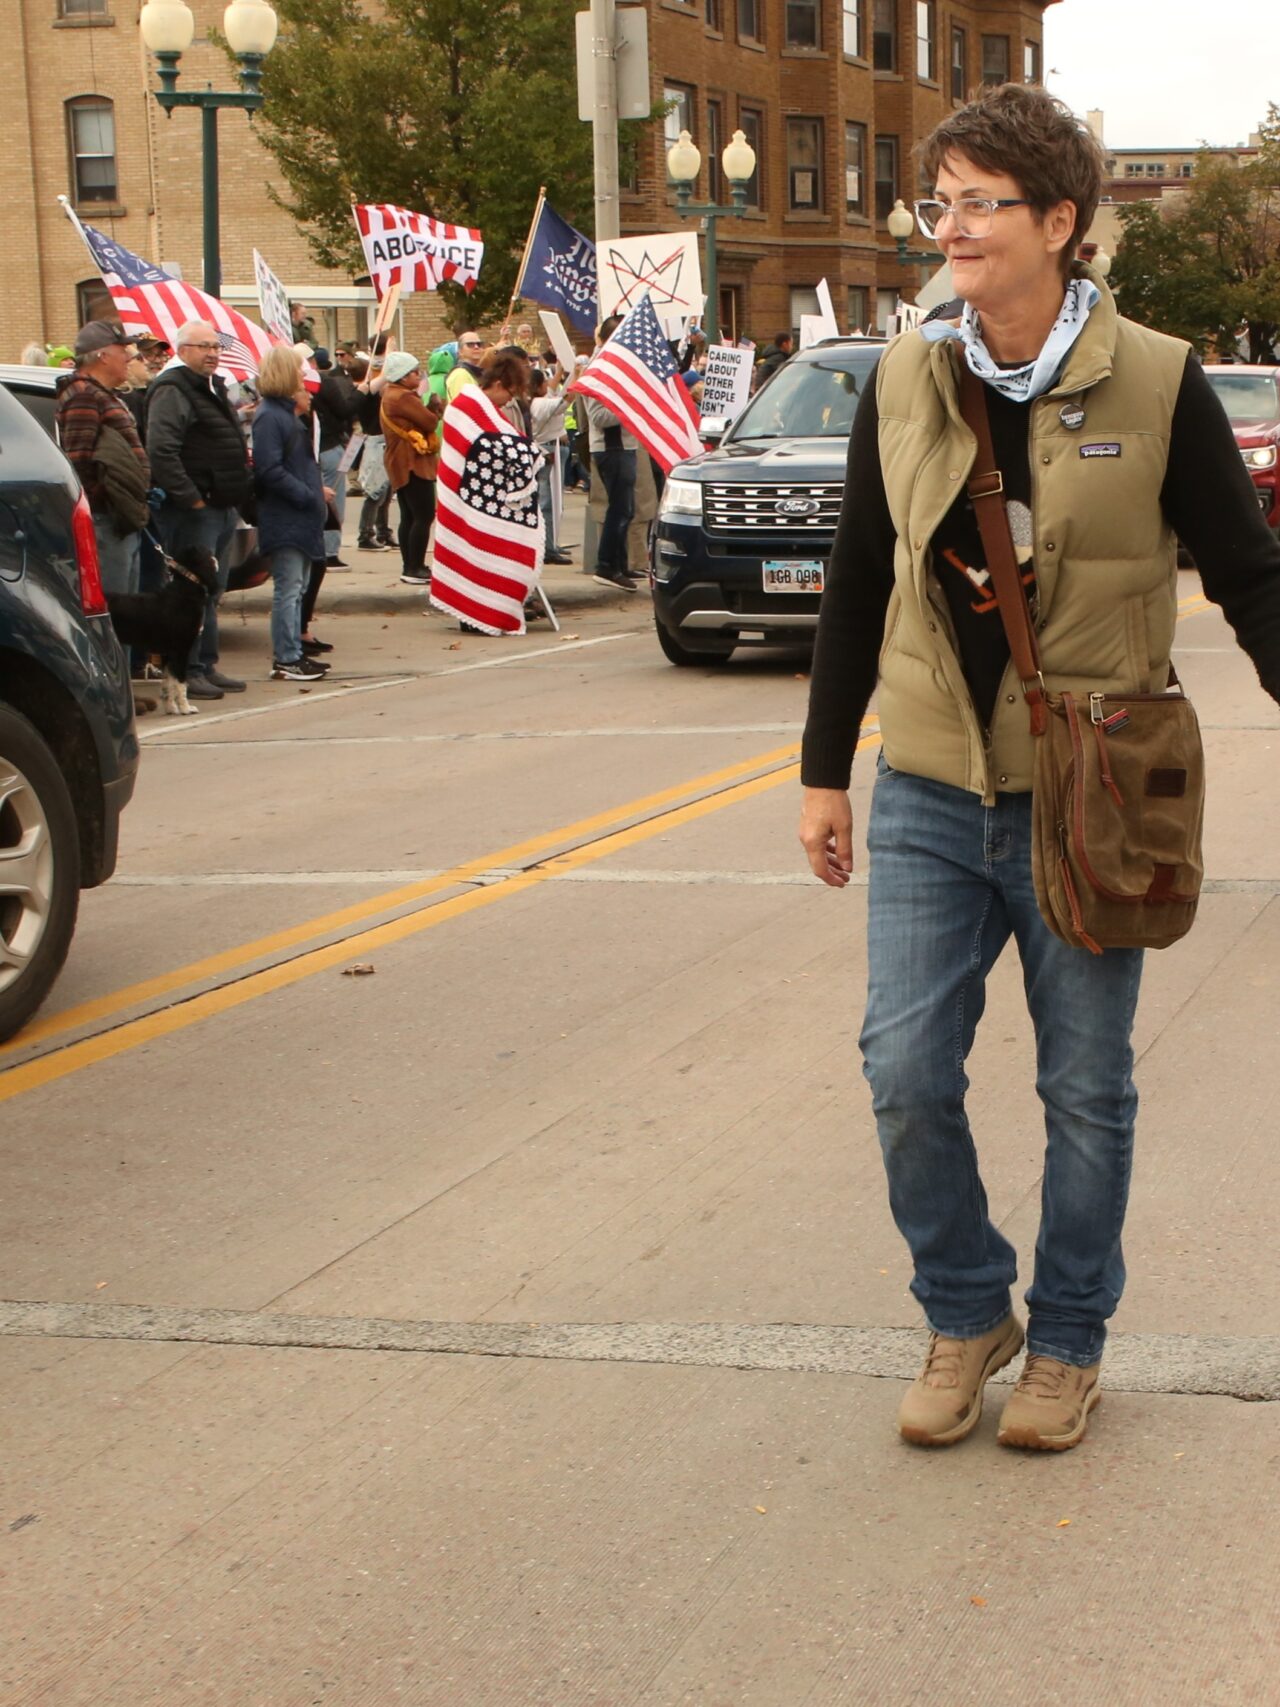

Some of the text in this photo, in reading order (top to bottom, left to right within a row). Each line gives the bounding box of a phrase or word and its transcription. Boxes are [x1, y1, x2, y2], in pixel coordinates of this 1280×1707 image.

[709, 351, 742, 364] CARING
[707, 363, 738, 377] ABOUT
[705, 376, 734, 390] OTHER
[703, 388, 735, 403] PEOPLE
[701, 401, 725, 414] ISN'T
[1084, 449, 1117, 457] patagonia
[783, 500, 809, 512] Ford
[770, 569, 819, 584] 1GB 098
